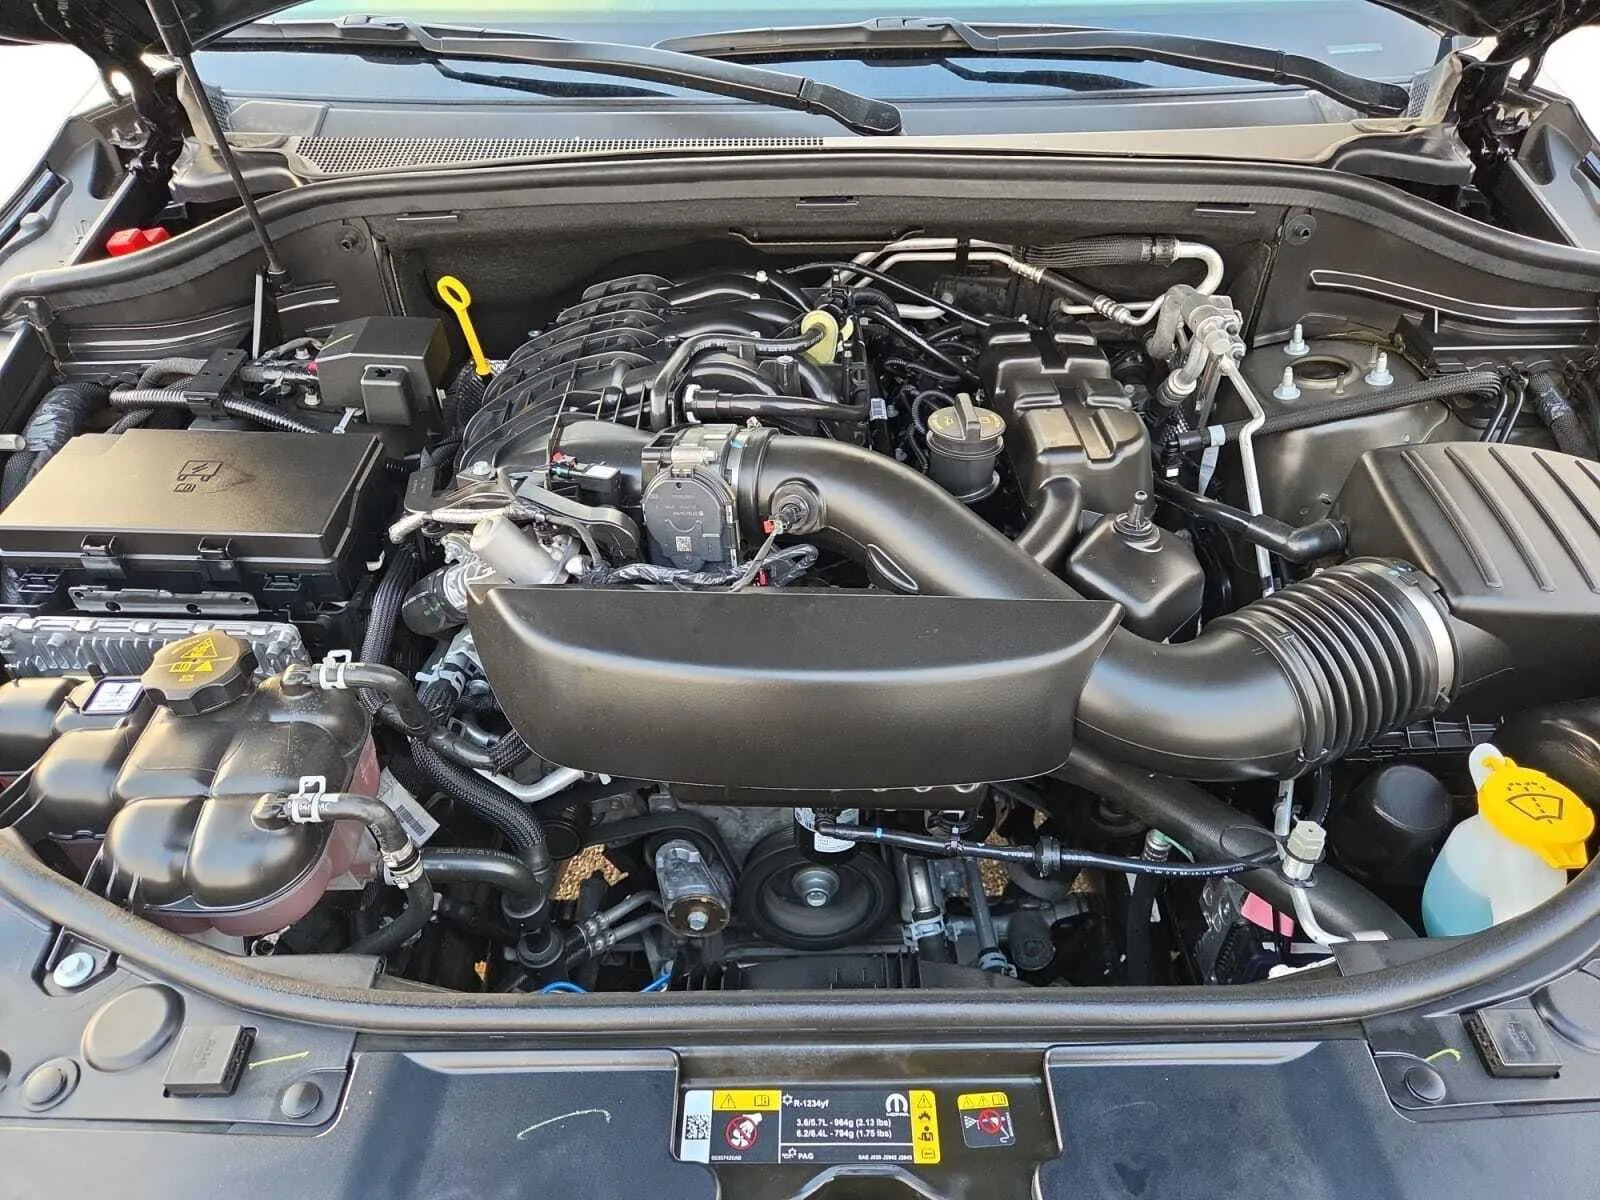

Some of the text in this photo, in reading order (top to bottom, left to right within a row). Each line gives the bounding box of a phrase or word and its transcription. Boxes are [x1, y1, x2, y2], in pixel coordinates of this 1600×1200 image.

[793, 1099, 829, 1109] R-1234yf
[876, 1118, 891, 1128] lbs)
[876, 1129, 892, 1139] lbs)
[798, 1152, 814, 1160] PAG
